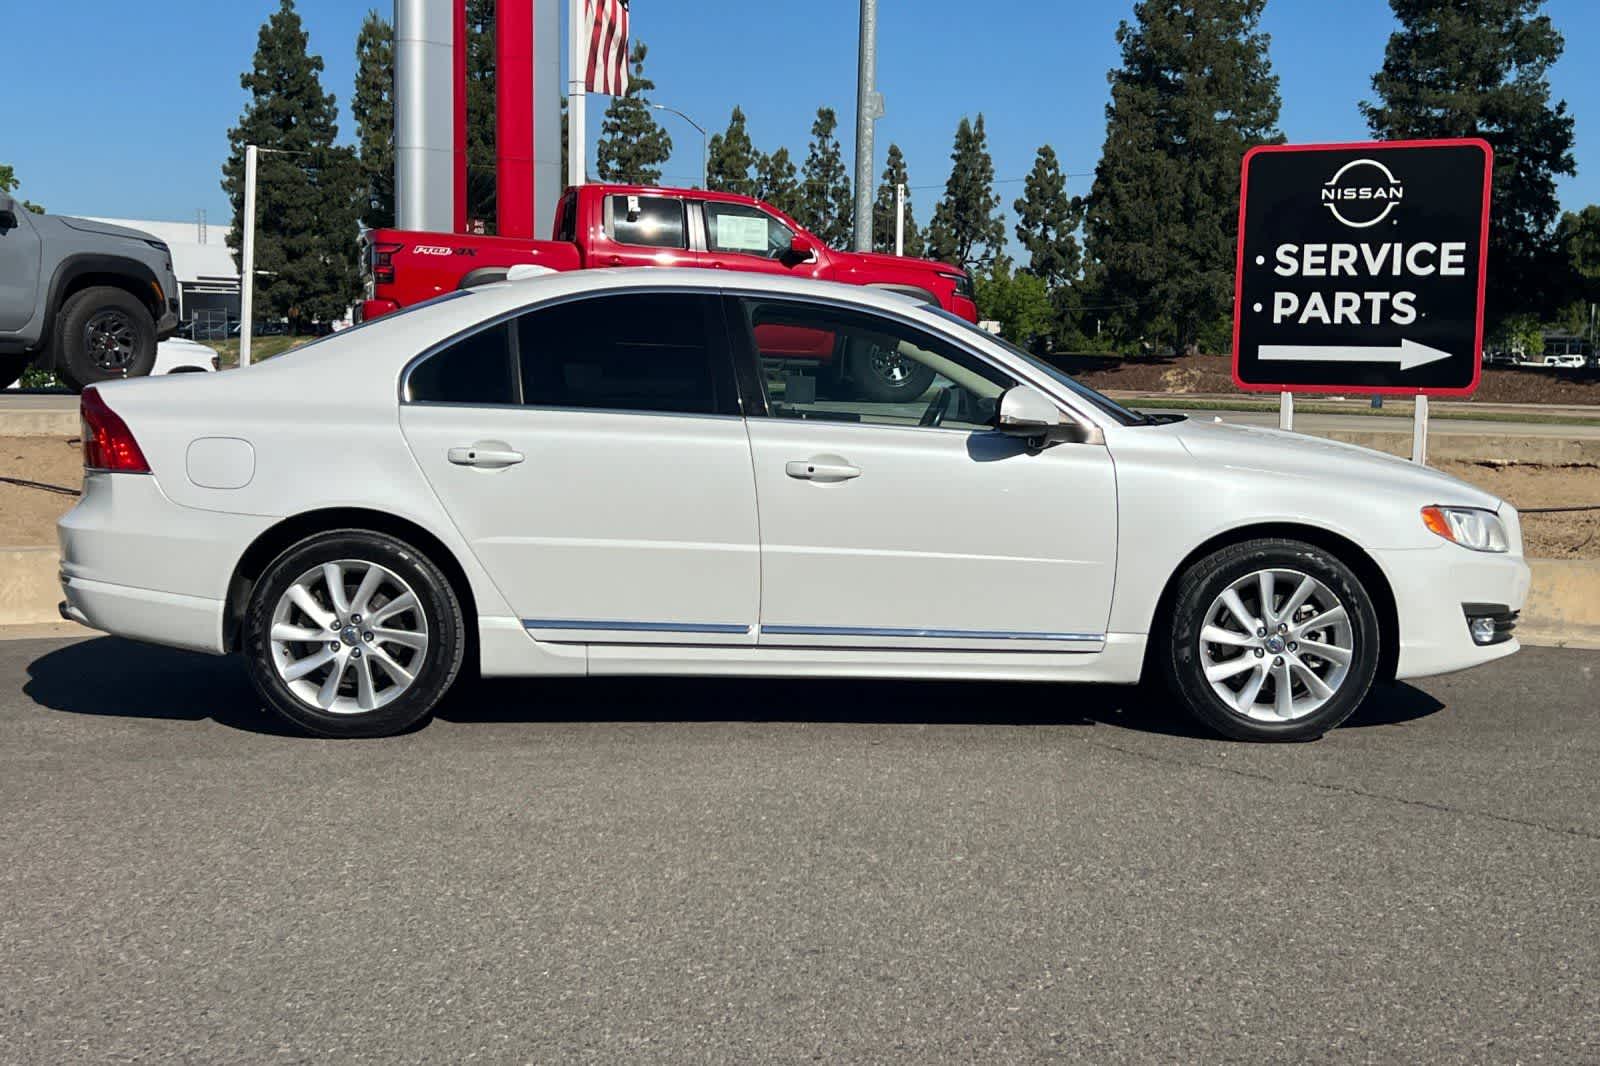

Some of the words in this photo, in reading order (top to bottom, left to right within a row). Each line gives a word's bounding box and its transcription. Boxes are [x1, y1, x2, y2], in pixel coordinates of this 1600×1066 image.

[1321, 187, 1403, 200] NISSAN
[1273, 242, 1466, 276] SERVICE
[1272, 291, 1417, 325] PARTS
